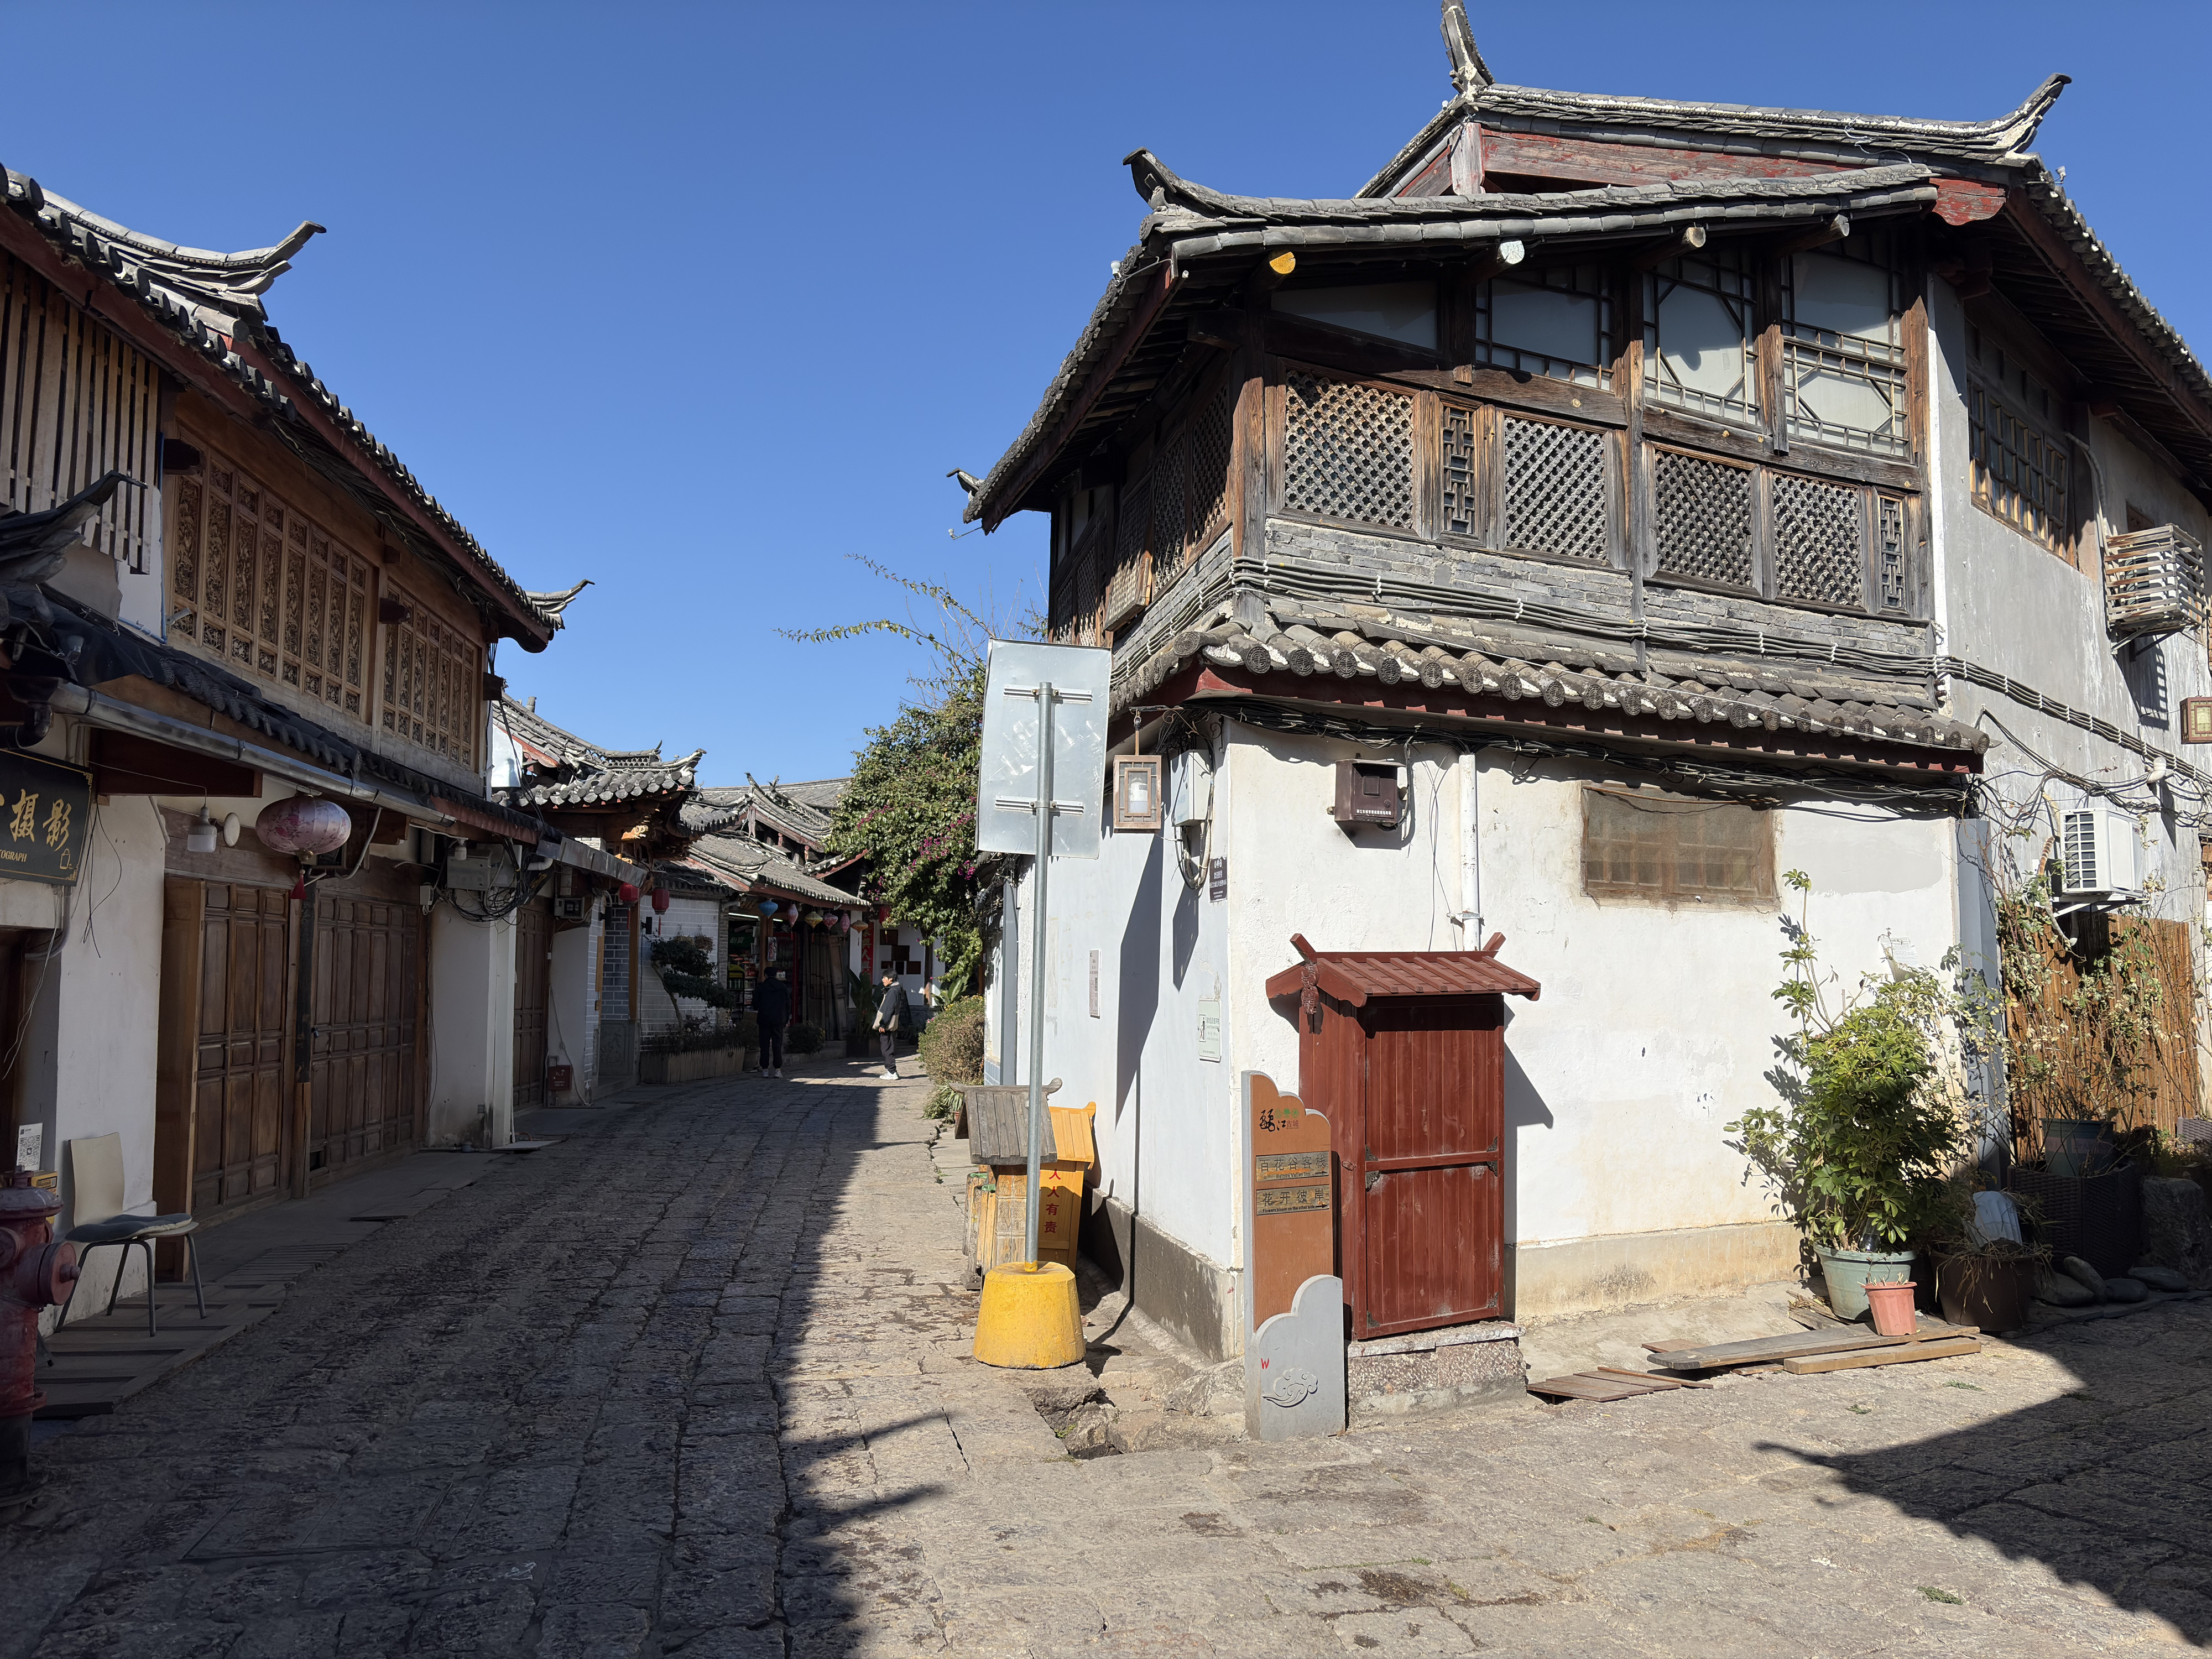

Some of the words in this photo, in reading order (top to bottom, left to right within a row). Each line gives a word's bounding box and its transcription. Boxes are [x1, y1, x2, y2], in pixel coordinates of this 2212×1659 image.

[0, 849, 27, 862] OGRAPH
[1260, 1155, 1327, 1172] 百花谷客栈
[1044, 1168, 1061, 1234] 人人有责
[1262, 1188, 1324, 1206] 花开彼岸
